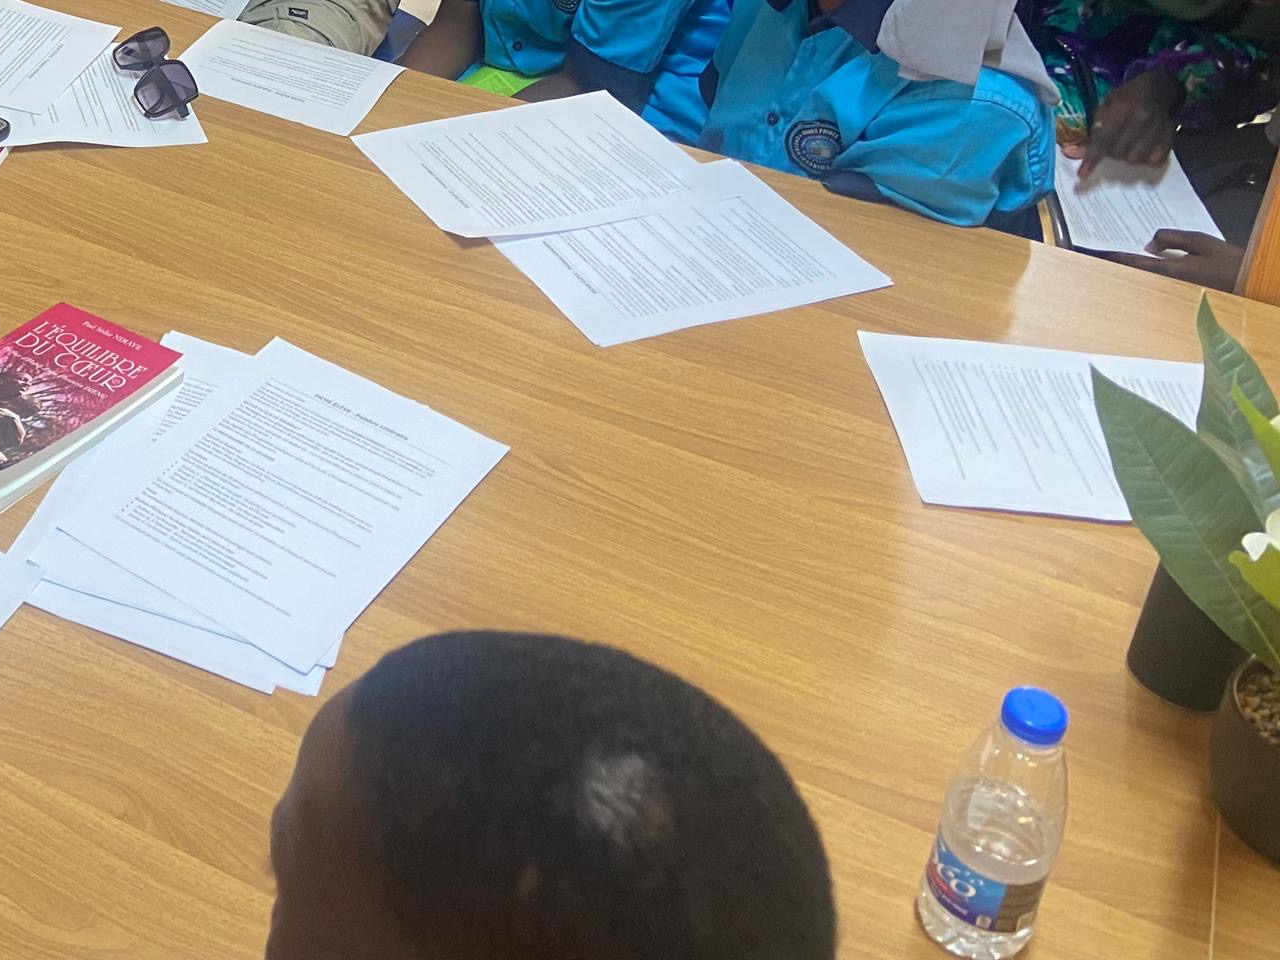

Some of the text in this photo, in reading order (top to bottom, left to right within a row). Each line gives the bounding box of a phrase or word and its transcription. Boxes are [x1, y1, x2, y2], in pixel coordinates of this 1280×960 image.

[14, 332, 56, 356] DU
[54, 352, 127, 393] CŒUR
[33, 321, 148, 379] L'ÉQUILIBRE
